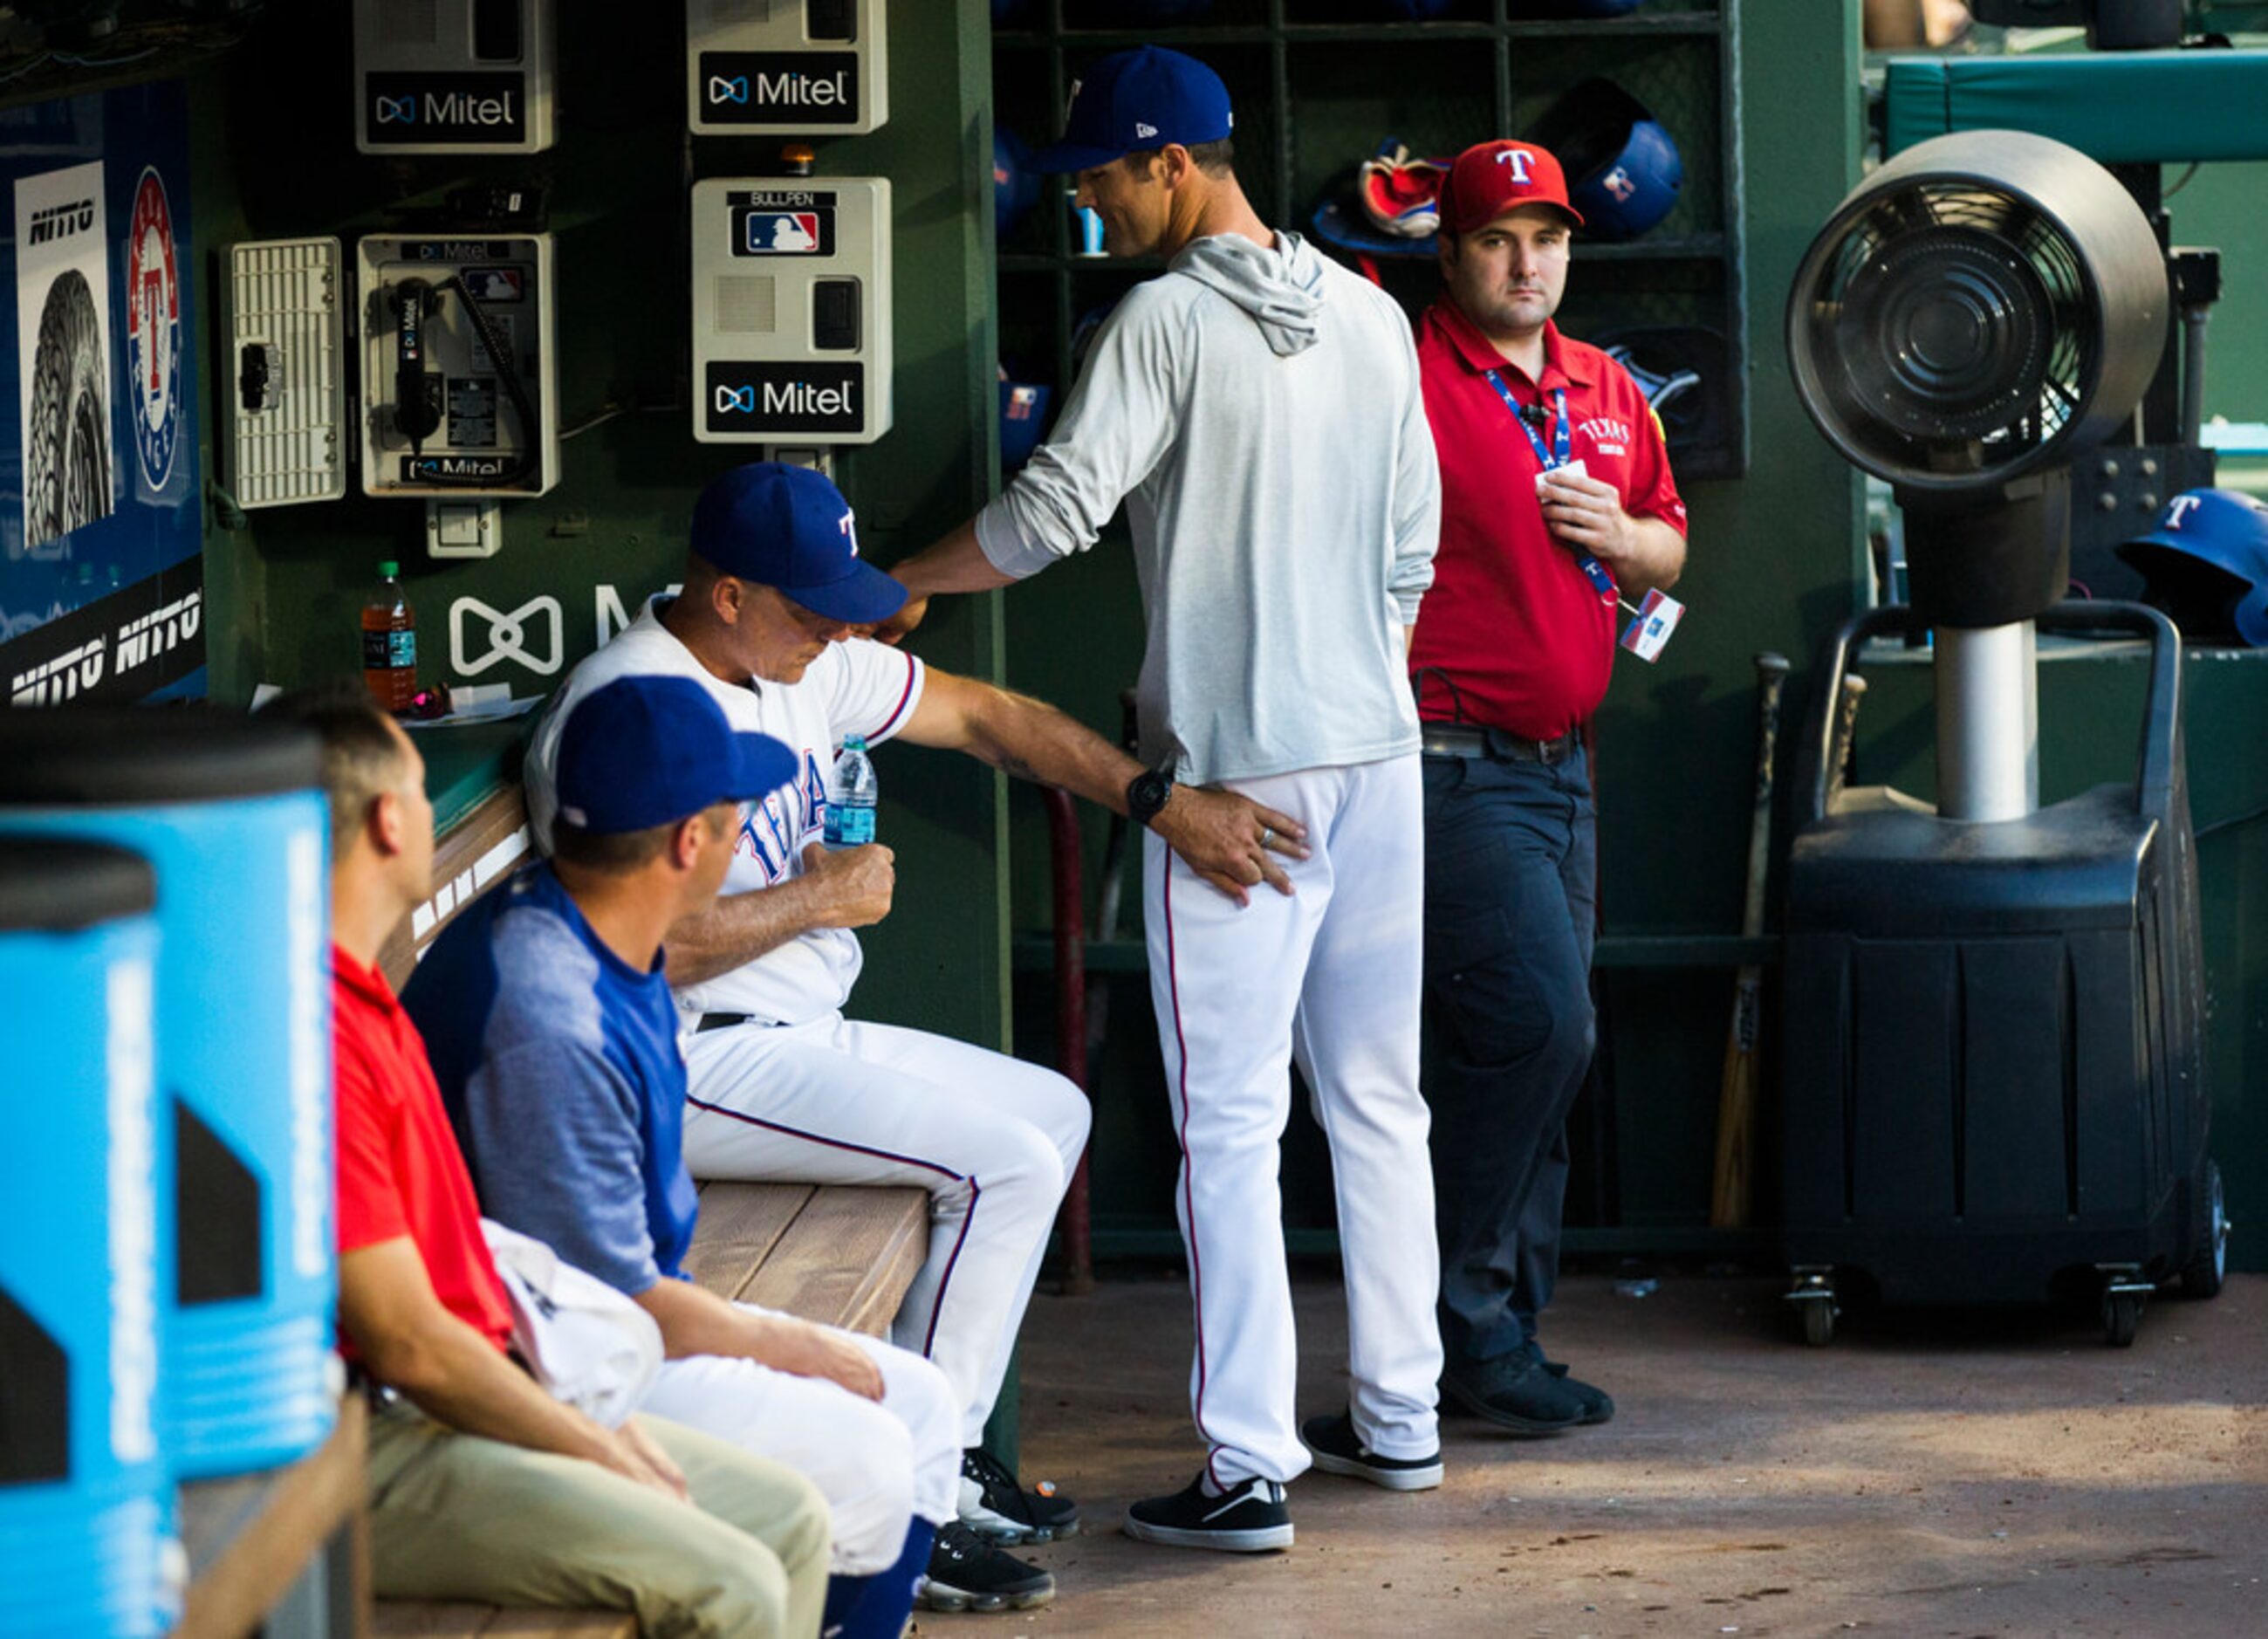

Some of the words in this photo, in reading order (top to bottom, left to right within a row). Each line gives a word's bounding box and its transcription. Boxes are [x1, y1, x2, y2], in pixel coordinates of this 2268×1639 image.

[756, 70, 847, 106] Mitel
[423, 90, 515, 125] Mitel
[1495, 149, 1536, 186] T
[750, 191, 814, 207] BULLPEN
[29, 198, 93, 246] NITTO
[763, 380, 853, 415] Mitel
[2165, 494, 2202, 531] T
[839, 506, 859, 559] T
[11, 637, 106, 708] NITTO
[115, 591, 201, 676] NITTO
